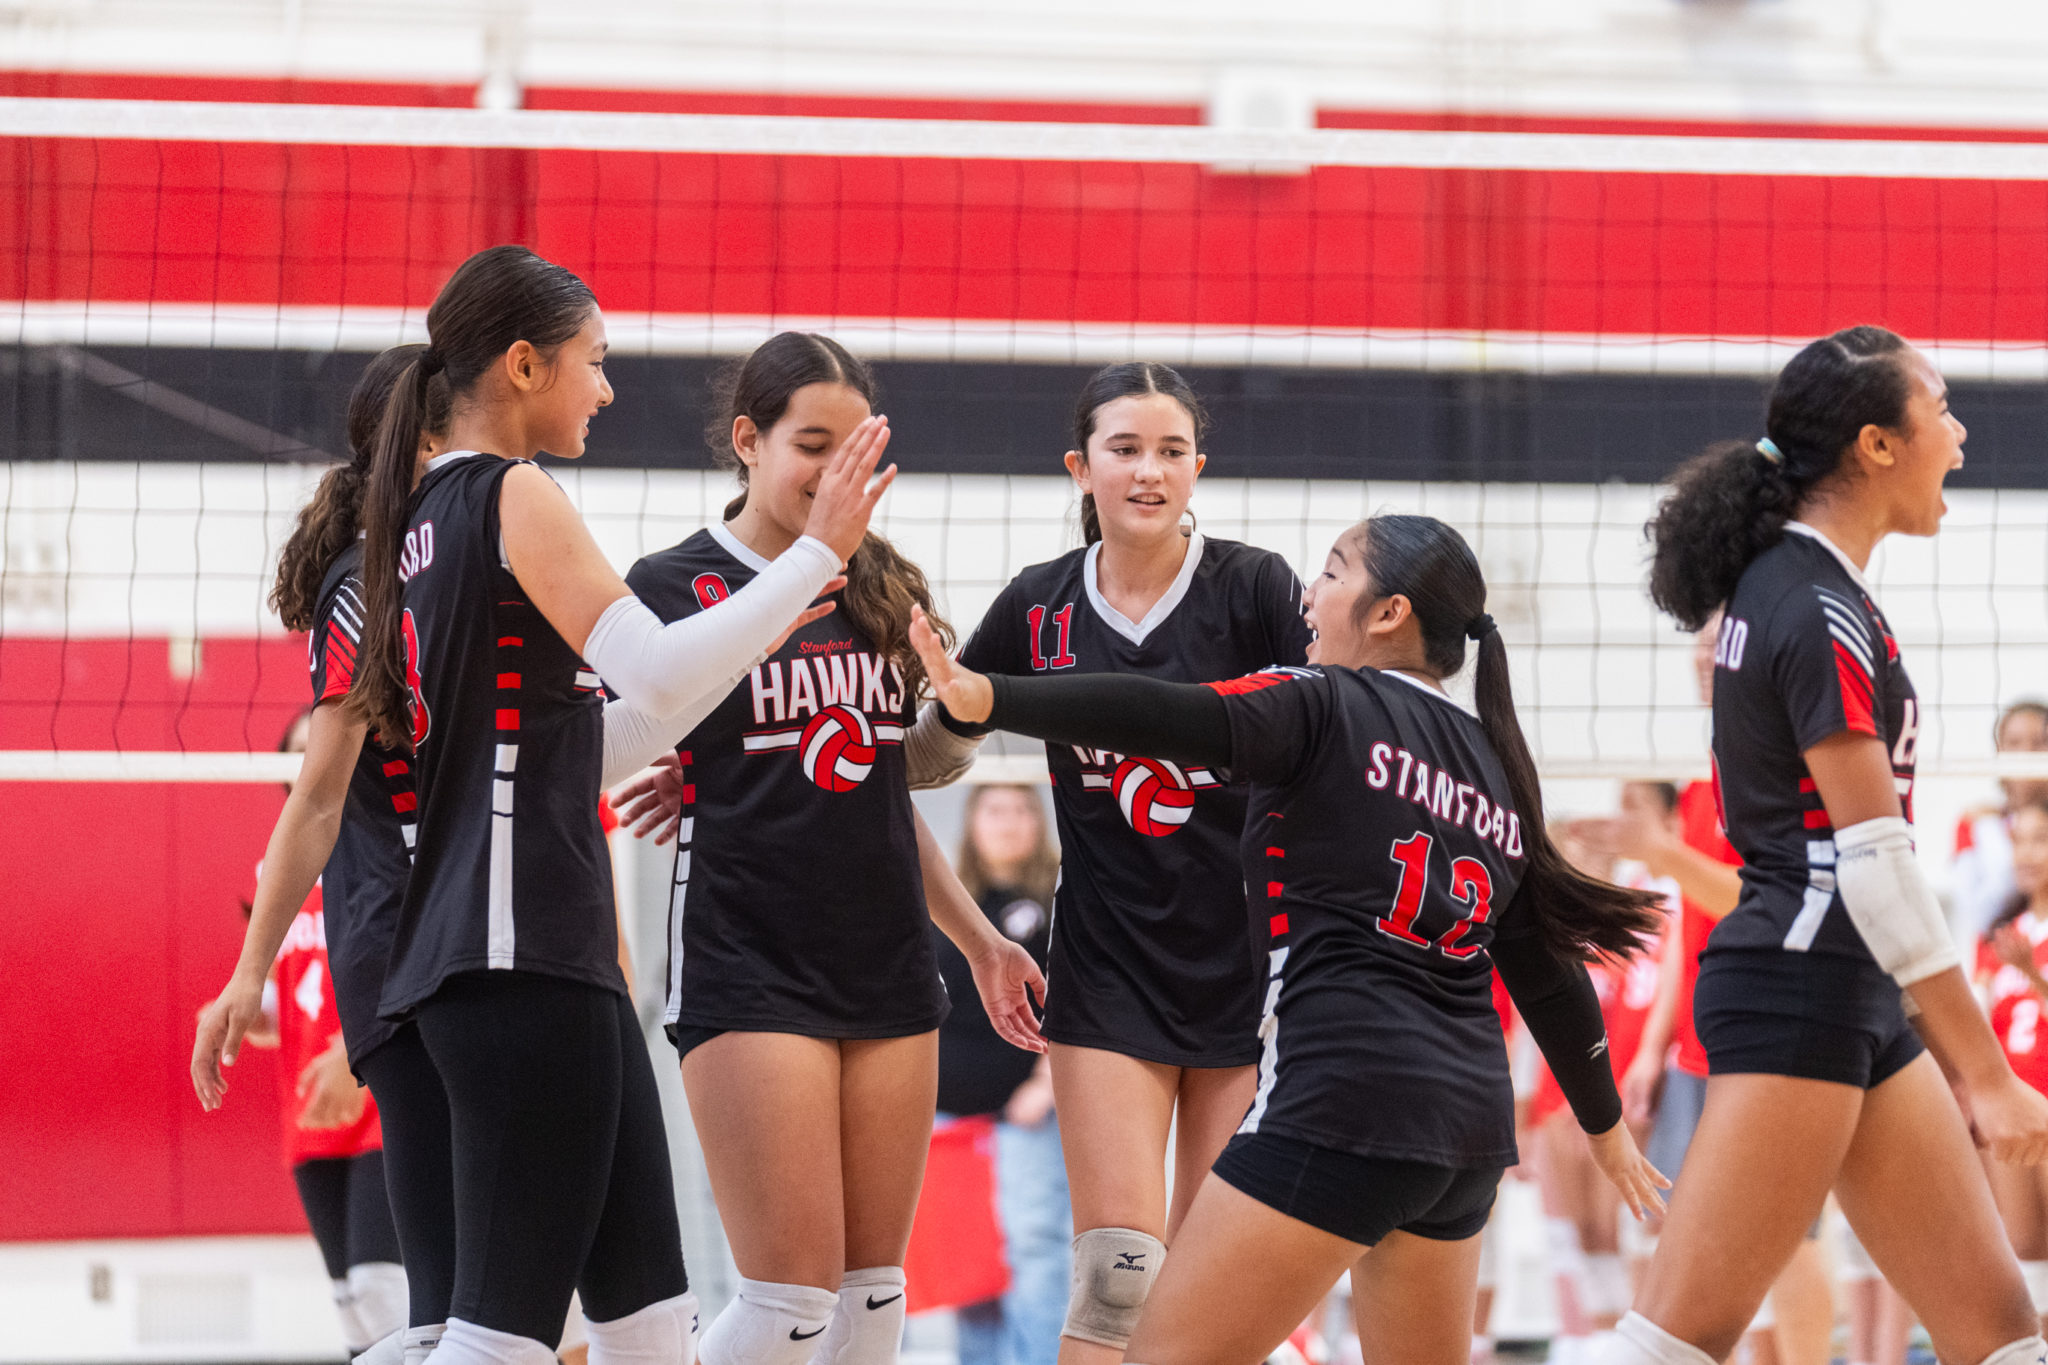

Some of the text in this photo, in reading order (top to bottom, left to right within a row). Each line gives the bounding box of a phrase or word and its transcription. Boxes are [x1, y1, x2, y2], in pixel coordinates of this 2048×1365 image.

[799, 638, 853, 658] Stanford
[1027, 603, 1076, 671] 11
[750, 652, 905, 724] HAWKS
[1366, 741, 1524, 860] STANFORD
[1376, 830, 1493, 960] 12
[295, 959, 324, 1021] 4
[2008, 999, 2039, 1054] 2
